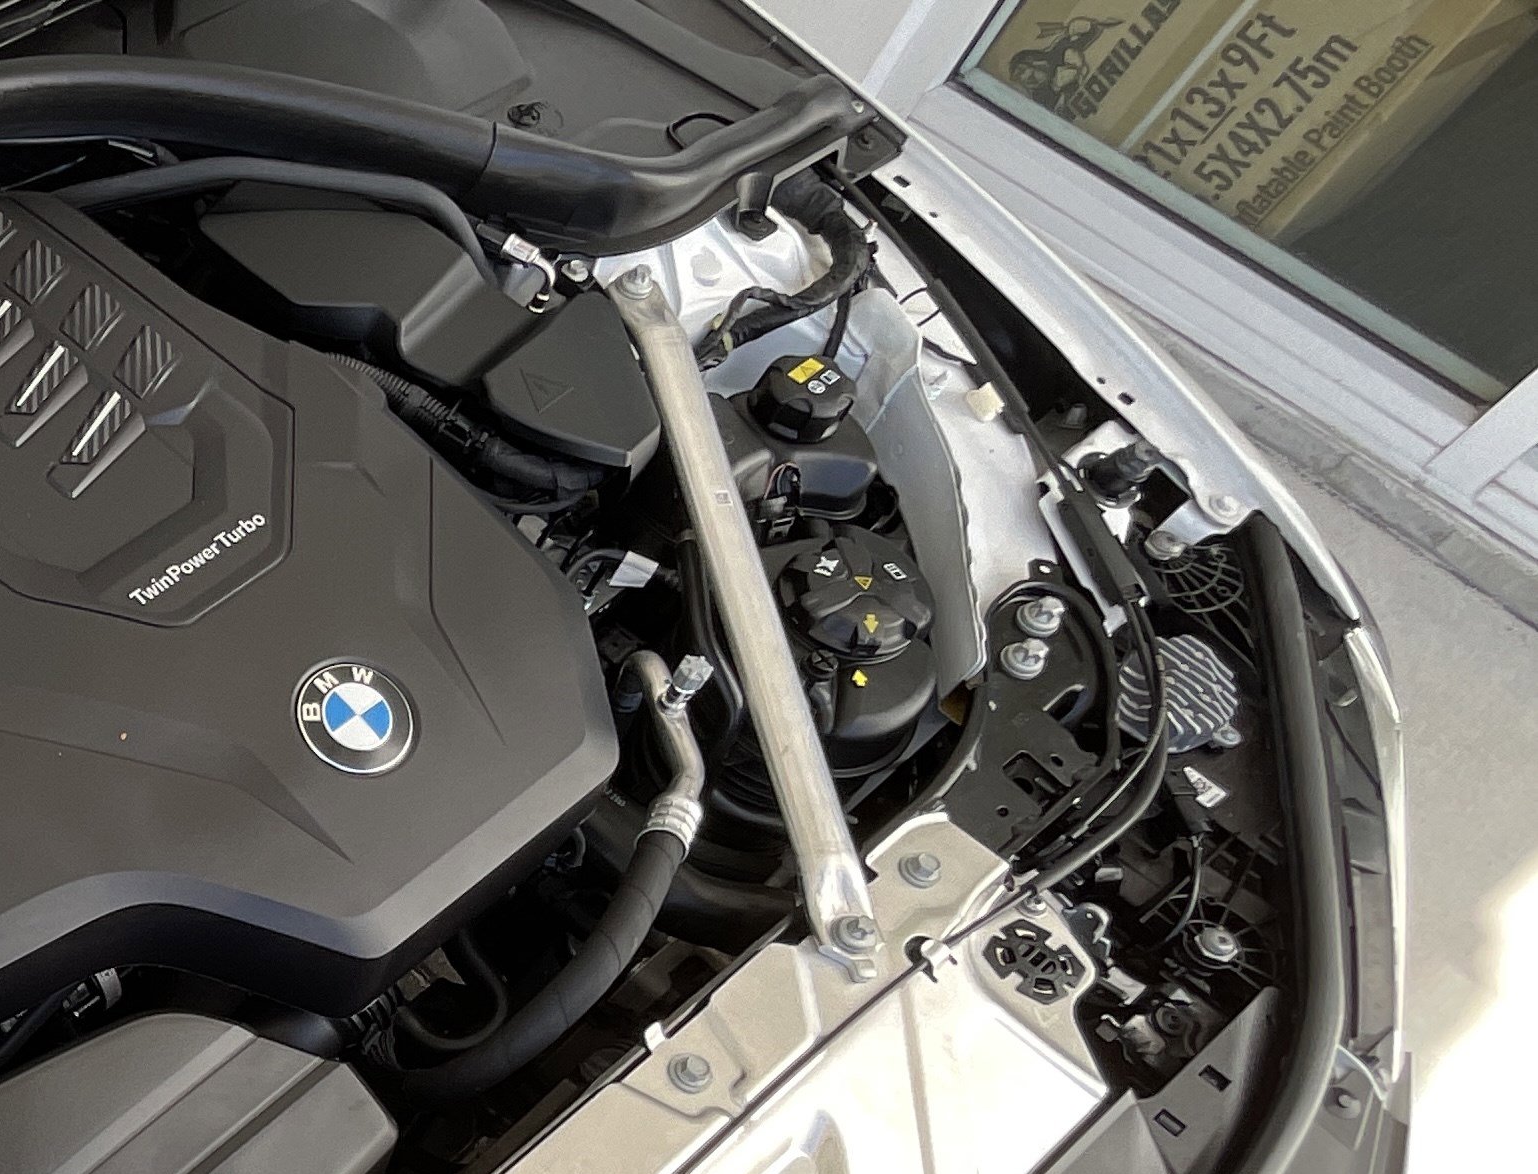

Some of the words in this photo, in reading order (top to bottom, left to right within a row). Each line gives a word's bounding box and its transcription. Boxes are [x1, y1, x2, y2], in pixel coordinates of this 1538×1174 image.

[1303, 93, 1370, 150] Paint
[1354, 34, 1431, 98] Booth
[128, 514, 266, 605] TwinPowerTurbo
[302, 666, 373, 721] BMW
